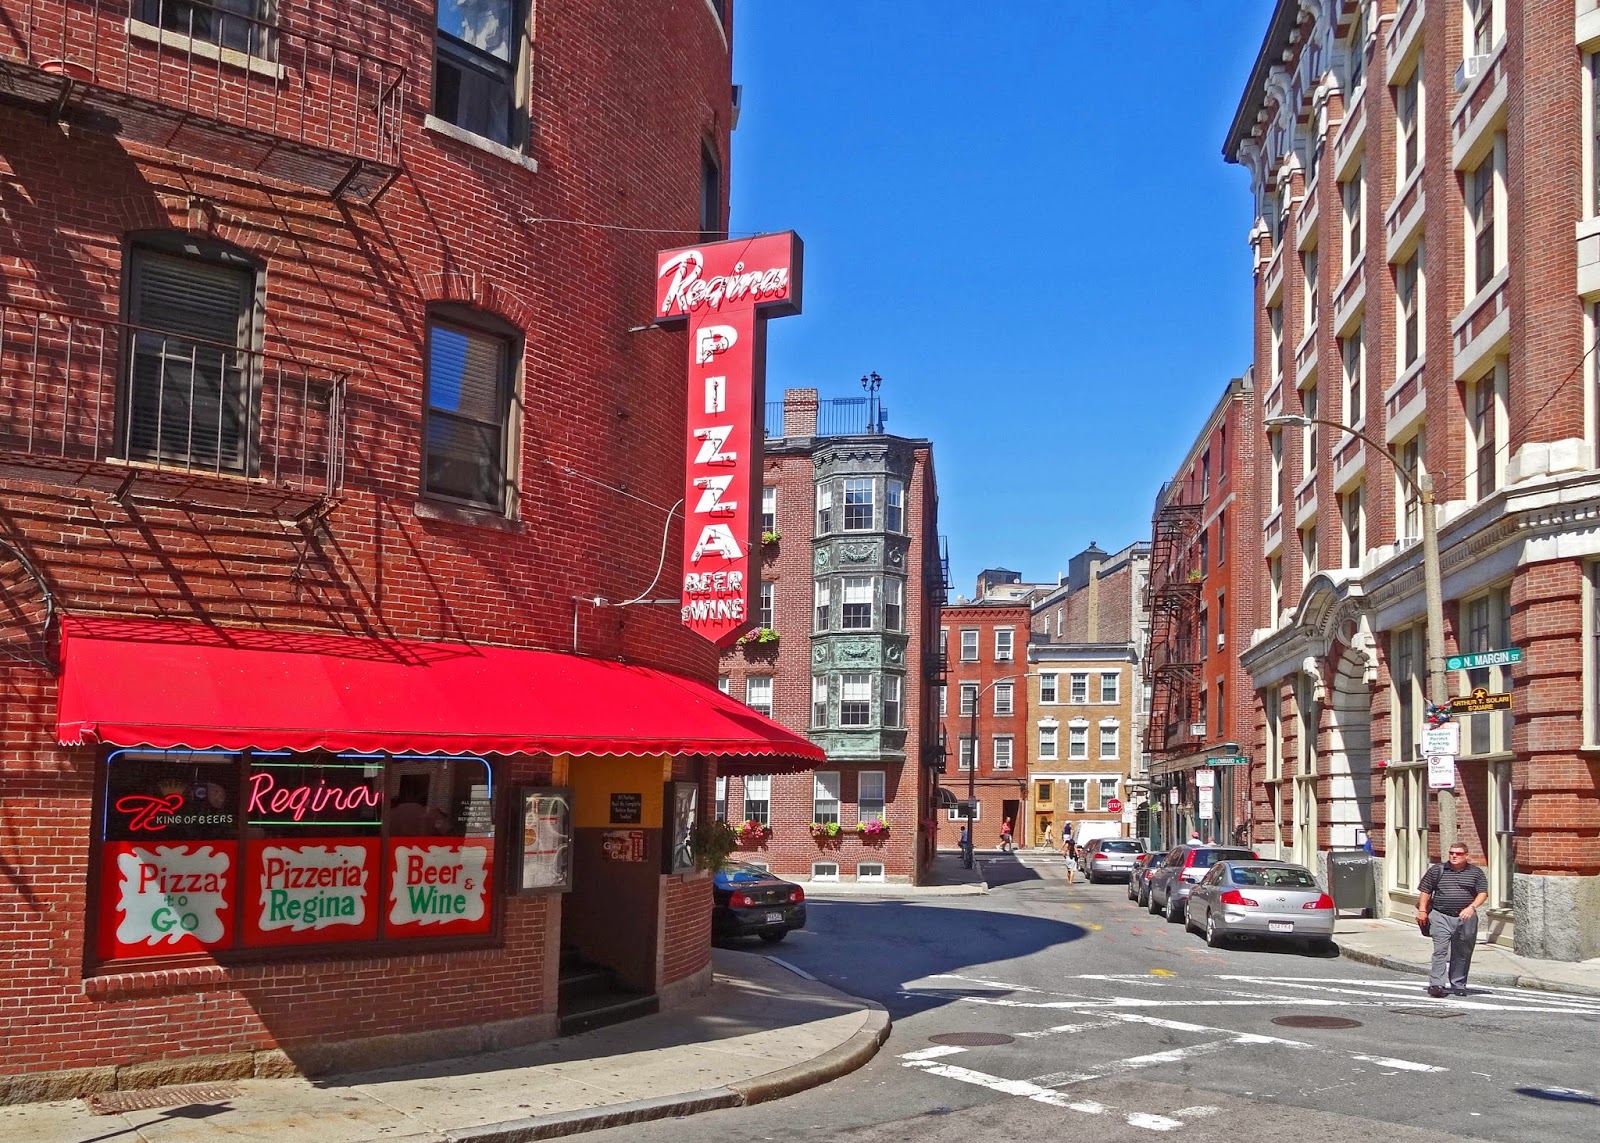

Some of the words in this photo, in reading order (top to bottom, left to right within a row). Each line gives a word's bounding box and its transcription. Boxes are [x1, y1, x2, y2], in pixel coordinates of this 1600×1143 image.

[658, 250, 789, 312] Regina
[690, 324, 744, 563] PIZZA
[684, 570, 744, 592] BEER
[1463, 656, 1473, 667] N.
[1475, 652, 1509, 665] MARGIN
[1511, 653, 1520, 661] ST
[248, 773, 380, 821] Regina
[156, 815, 182, 825] KING
[184, 815, 197, 824] OF
[198, 814, 233, 824] BEERS
[138, 863, 220, 893] Pizza
[265, 857, 362, 890] Pizzeria
[407, 855, 463, 885] Beer
[464, 878, 476, 889] &
[164, 895, 188, 906] to
[269, 889, 356, 924] Regina
[407, 885, 467, 914] Wine
